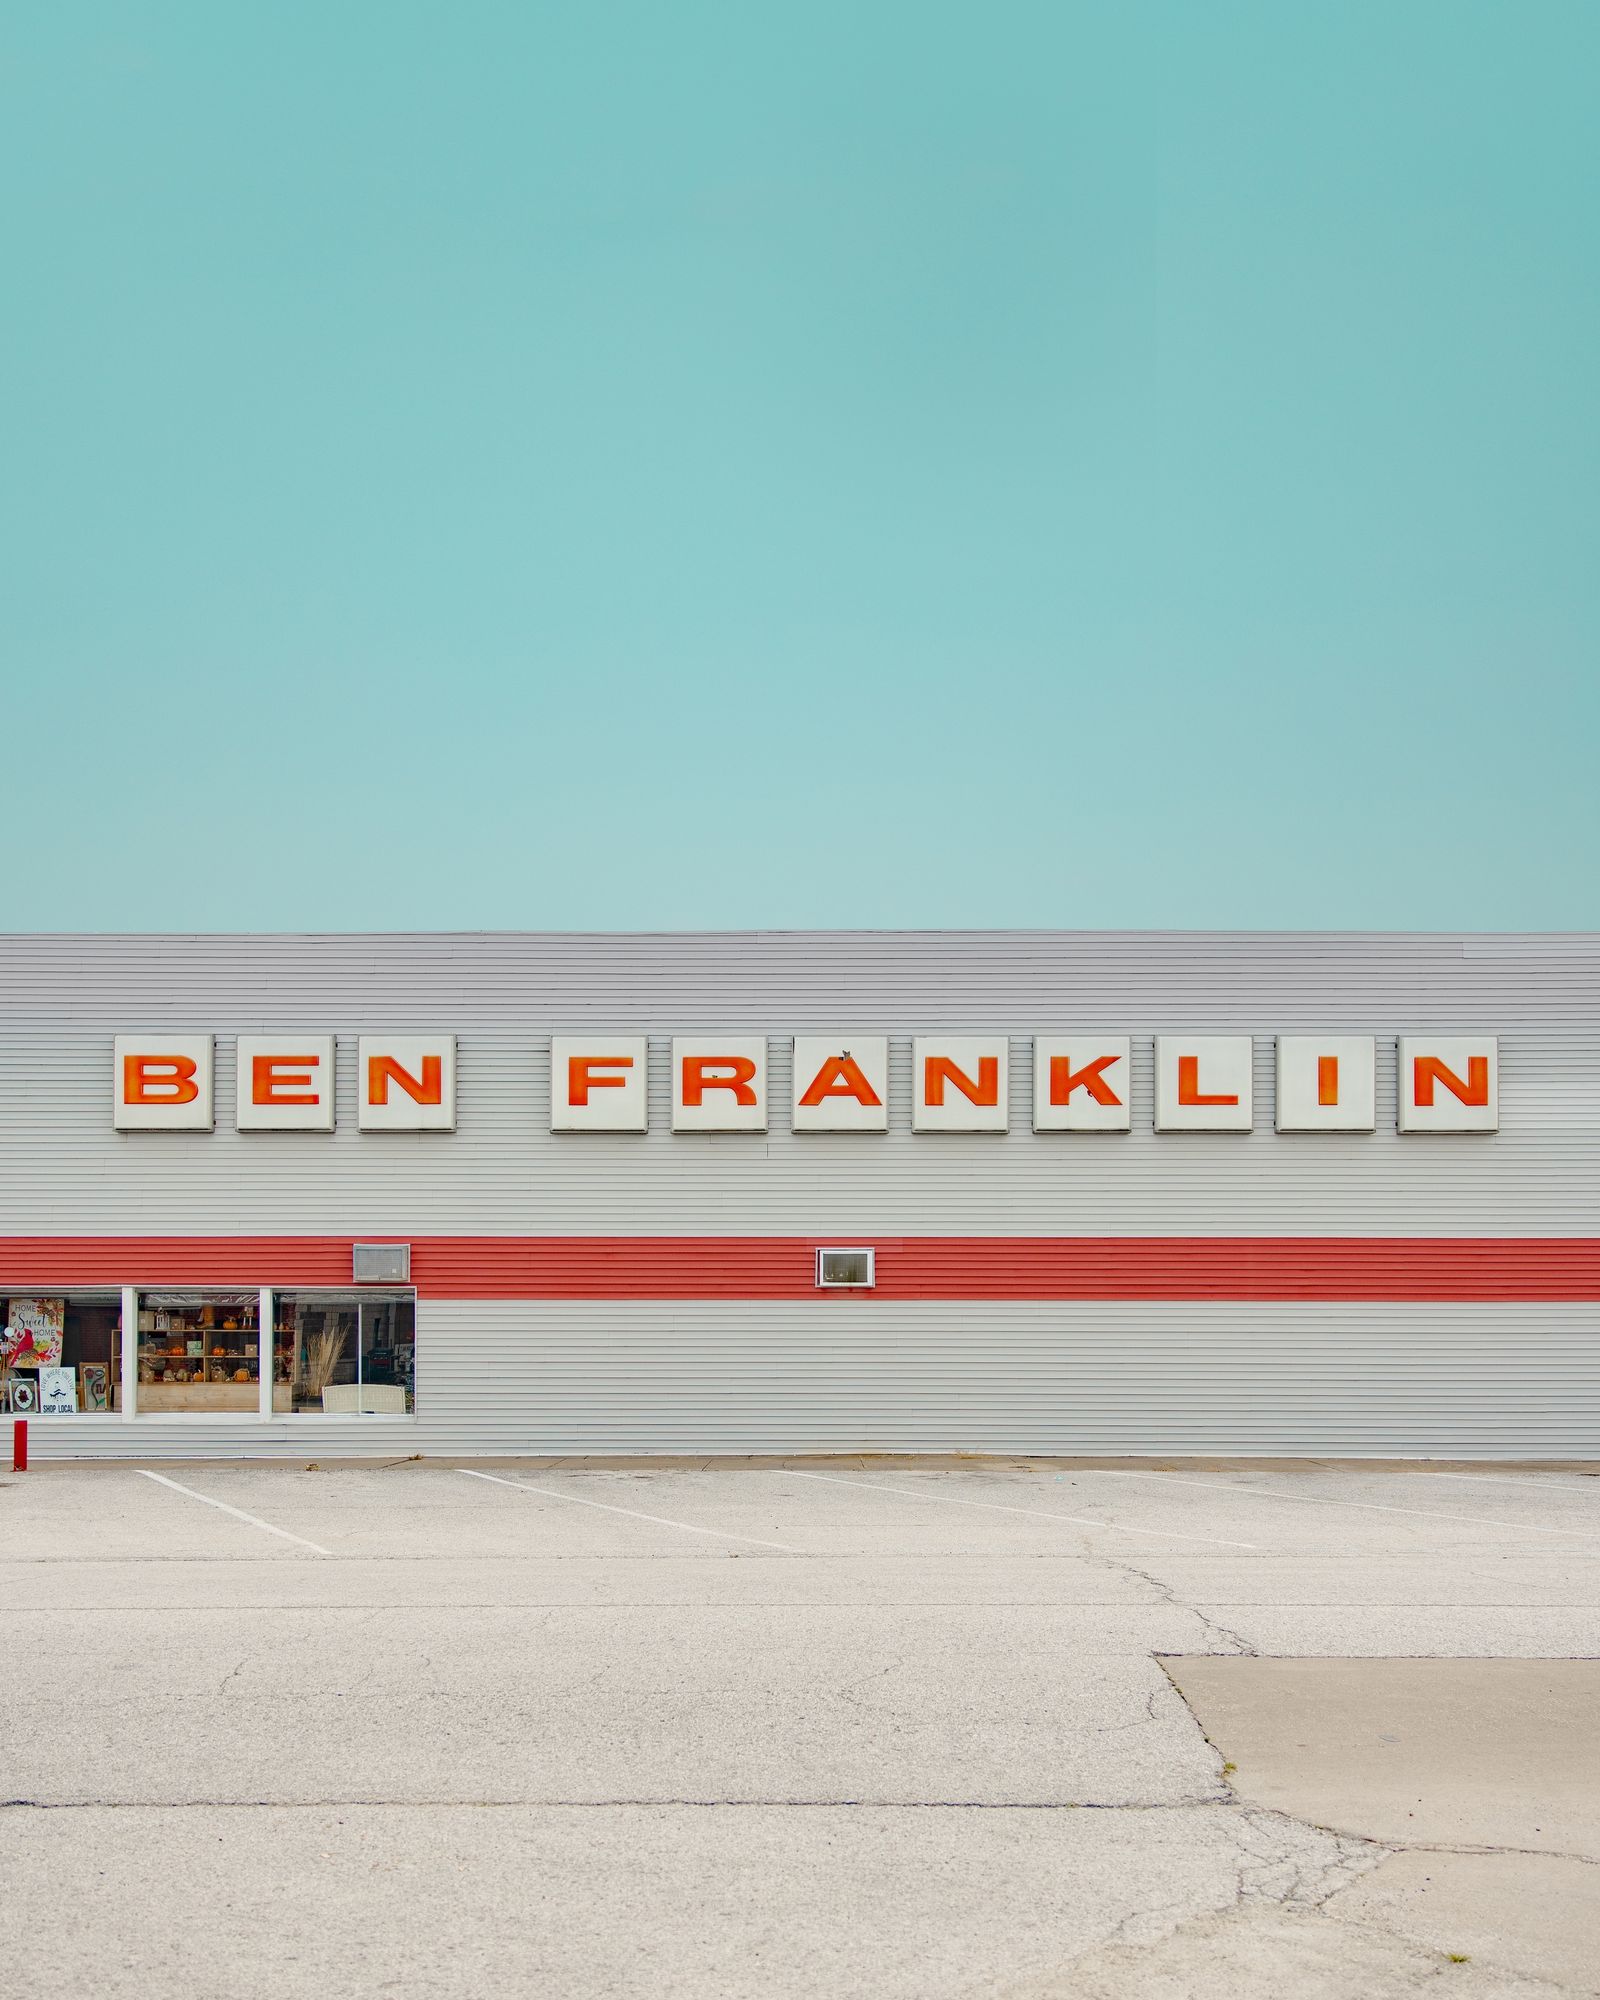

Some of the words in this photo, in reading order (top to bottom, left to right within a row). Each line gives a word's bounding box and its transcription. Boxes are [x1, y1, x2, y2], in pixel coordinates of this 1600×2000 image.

[123, 1055, 442, 1105] BEN
[568, 1056, 1489, 1106] FRANKLIN
[15, 1304, 36, 1312] HOME
[18, 1312, 47, 1330] Sweet
[43, 1404, 56, 1413] SHOP
[58, 1404, 74, 1413] LOCAL
